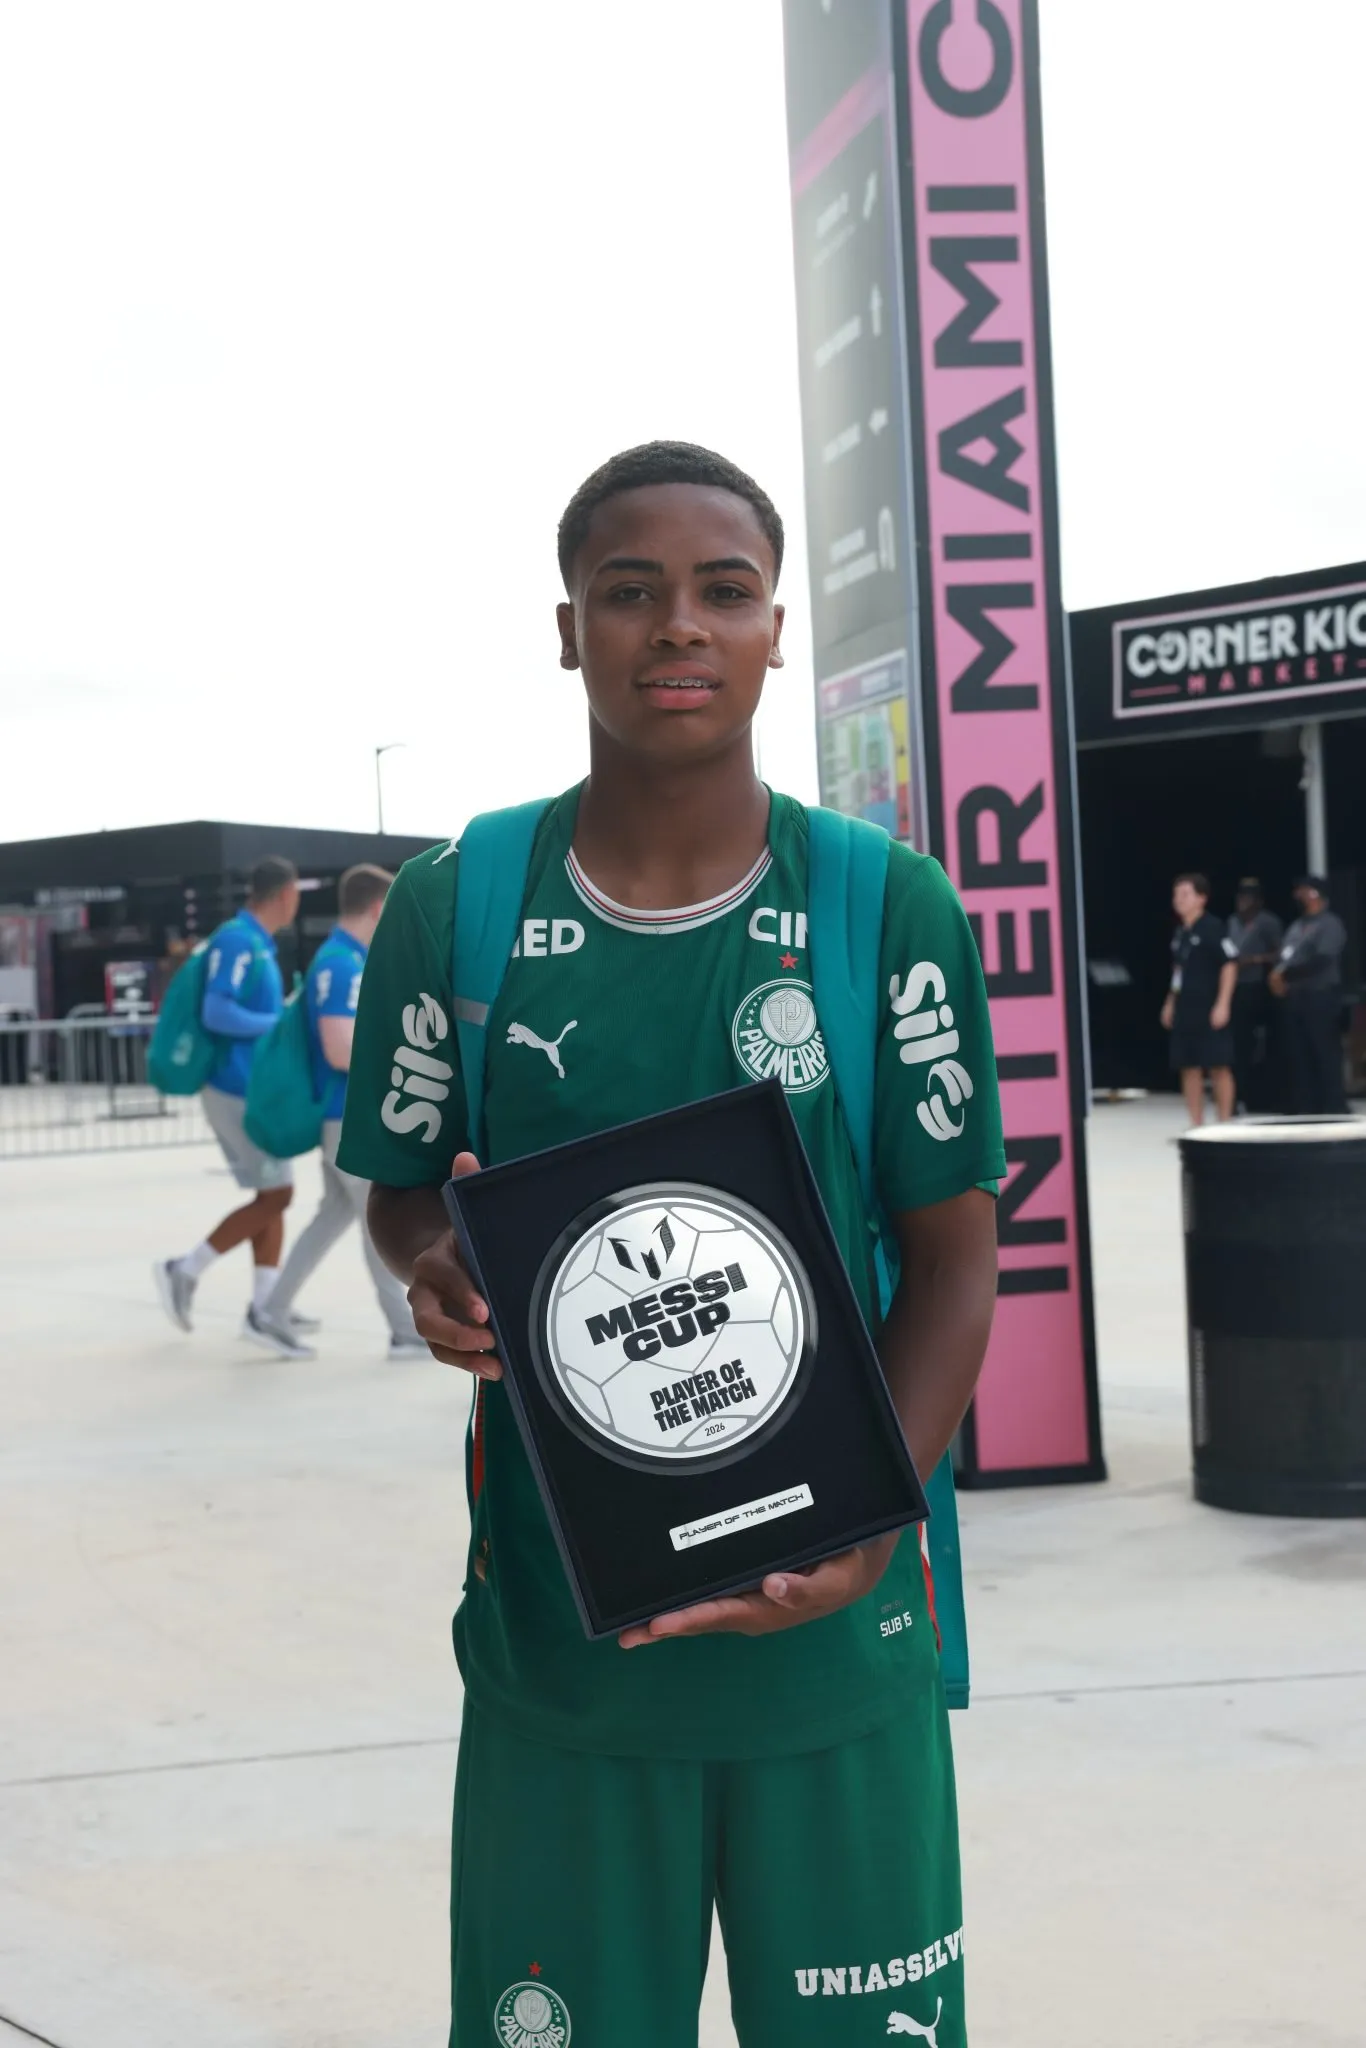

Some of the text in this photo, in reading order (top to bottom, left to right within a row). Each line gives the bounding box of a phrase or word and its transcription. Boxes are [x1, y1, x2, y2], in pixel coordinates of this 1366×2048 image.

[926, 185, 1041, 714] MIAMI
[1126, 613, 1298, 678] CORNER
[1187, 653, 1347, 694] MARKET
[584, 1261, 748, 1346] MESSI
[622, 1301, 731, 1362] CUP
[649, 1358, 745, 1412] PLAYER OF
[653, 1377, 758, 1433] THE MATCH
[704, 1422, 726, 1437] 2026
[679, 1493, 804, 1540] PLAYER OF THE MATCH
[879, 1616, 903, 1638] SUB
